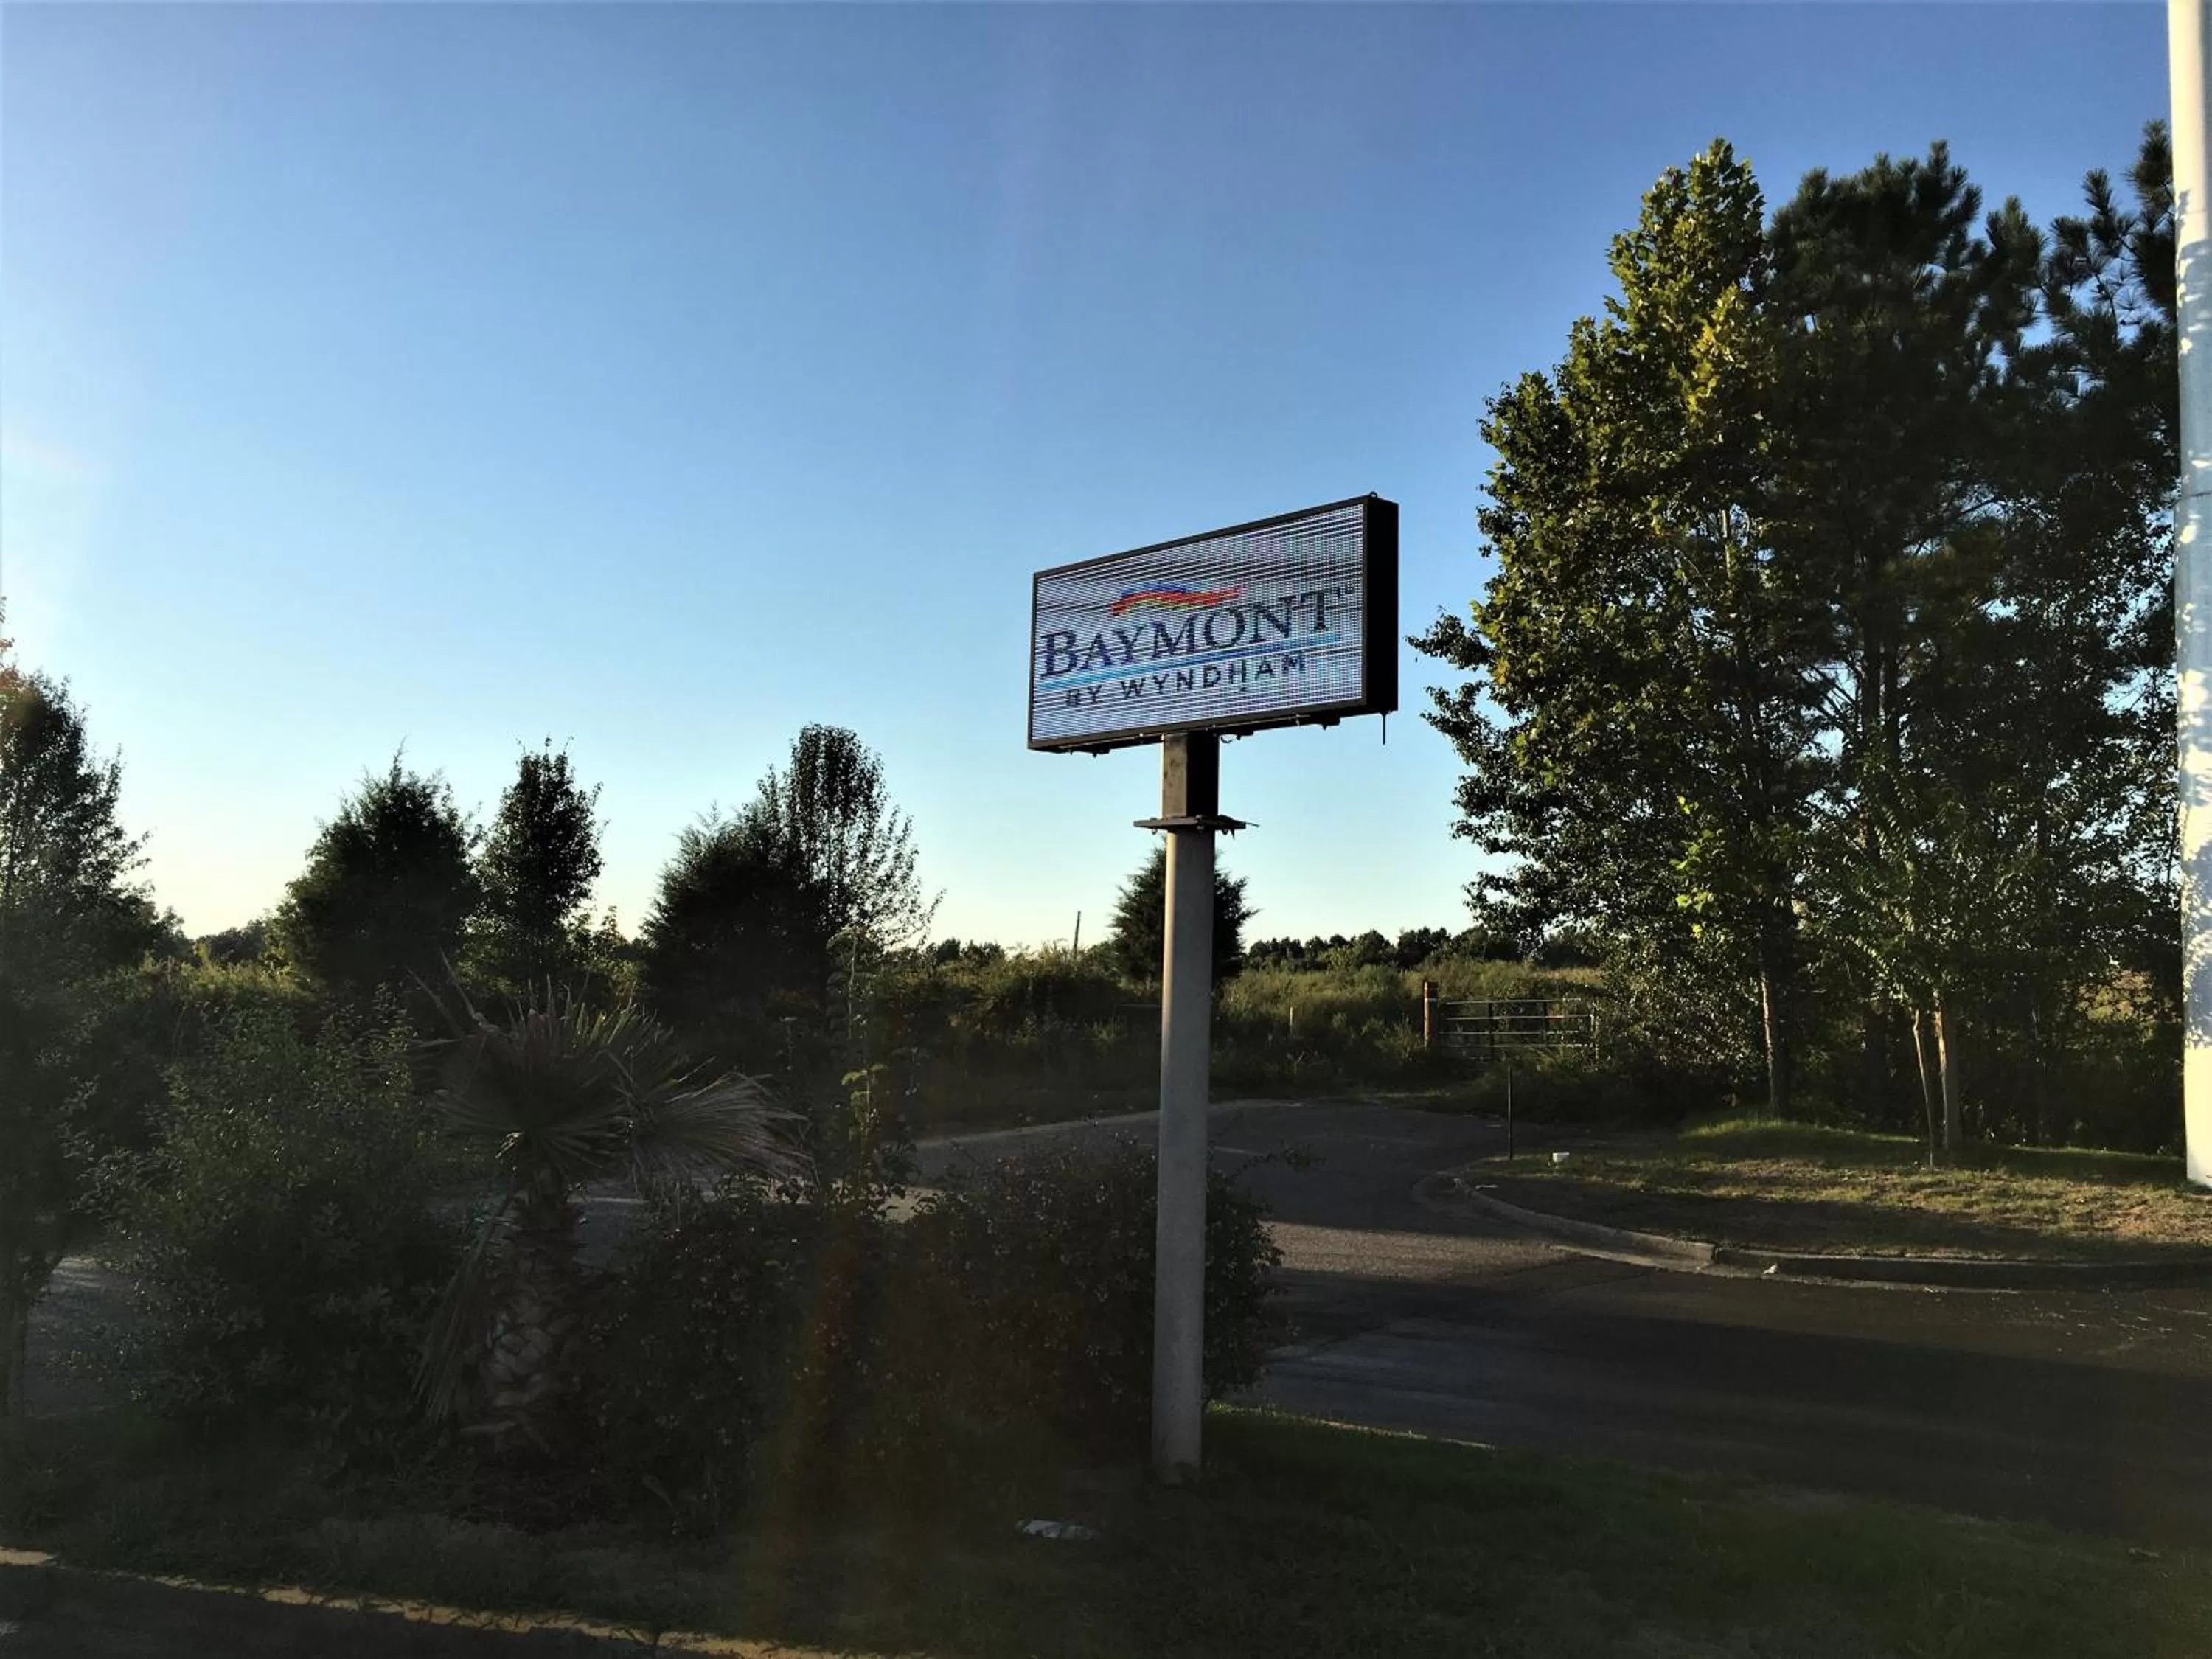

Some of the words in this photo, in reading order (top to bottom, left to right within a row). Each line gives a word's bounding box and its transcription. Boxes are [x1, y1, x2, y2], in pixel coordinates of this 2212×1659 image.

[1040, 590, 1333, 678] BAYMONT
[1066, 685, 1102, 706] BY
[1121, 653, 1306, 699] WYNDHAM
